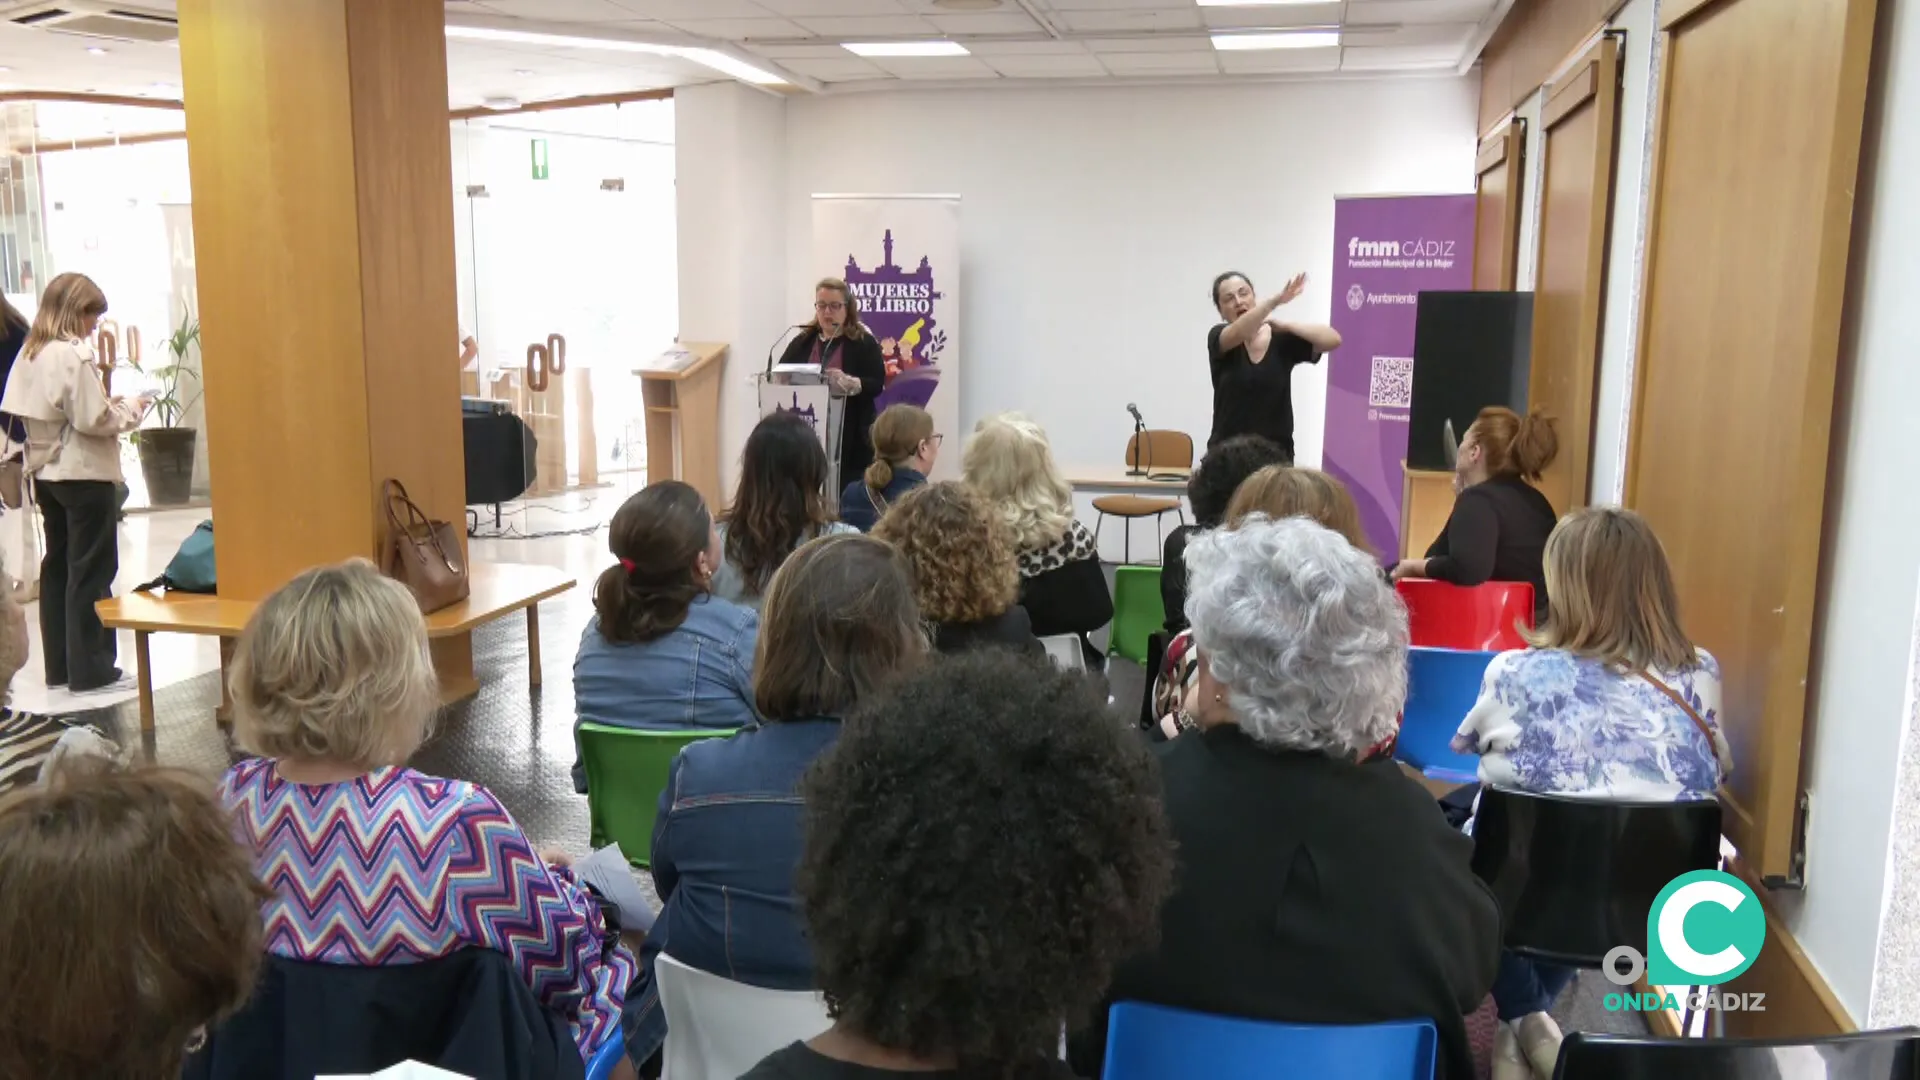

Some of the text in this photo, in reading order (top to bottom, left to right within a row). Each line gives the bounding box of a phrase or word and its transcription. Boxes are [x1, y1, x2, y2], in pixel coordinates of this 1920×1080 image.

[1348, 236, 1456, 257] fmm CÁDIZ
[1415, 259, 1425, 269] de
[1433, 259, 1454, 271] Mujer
[849, 283, 930, 298] MUJERES
[876, 299, 930, 313] LIBRO
[1366, 292, 1416, 306] Ayuntamiento
